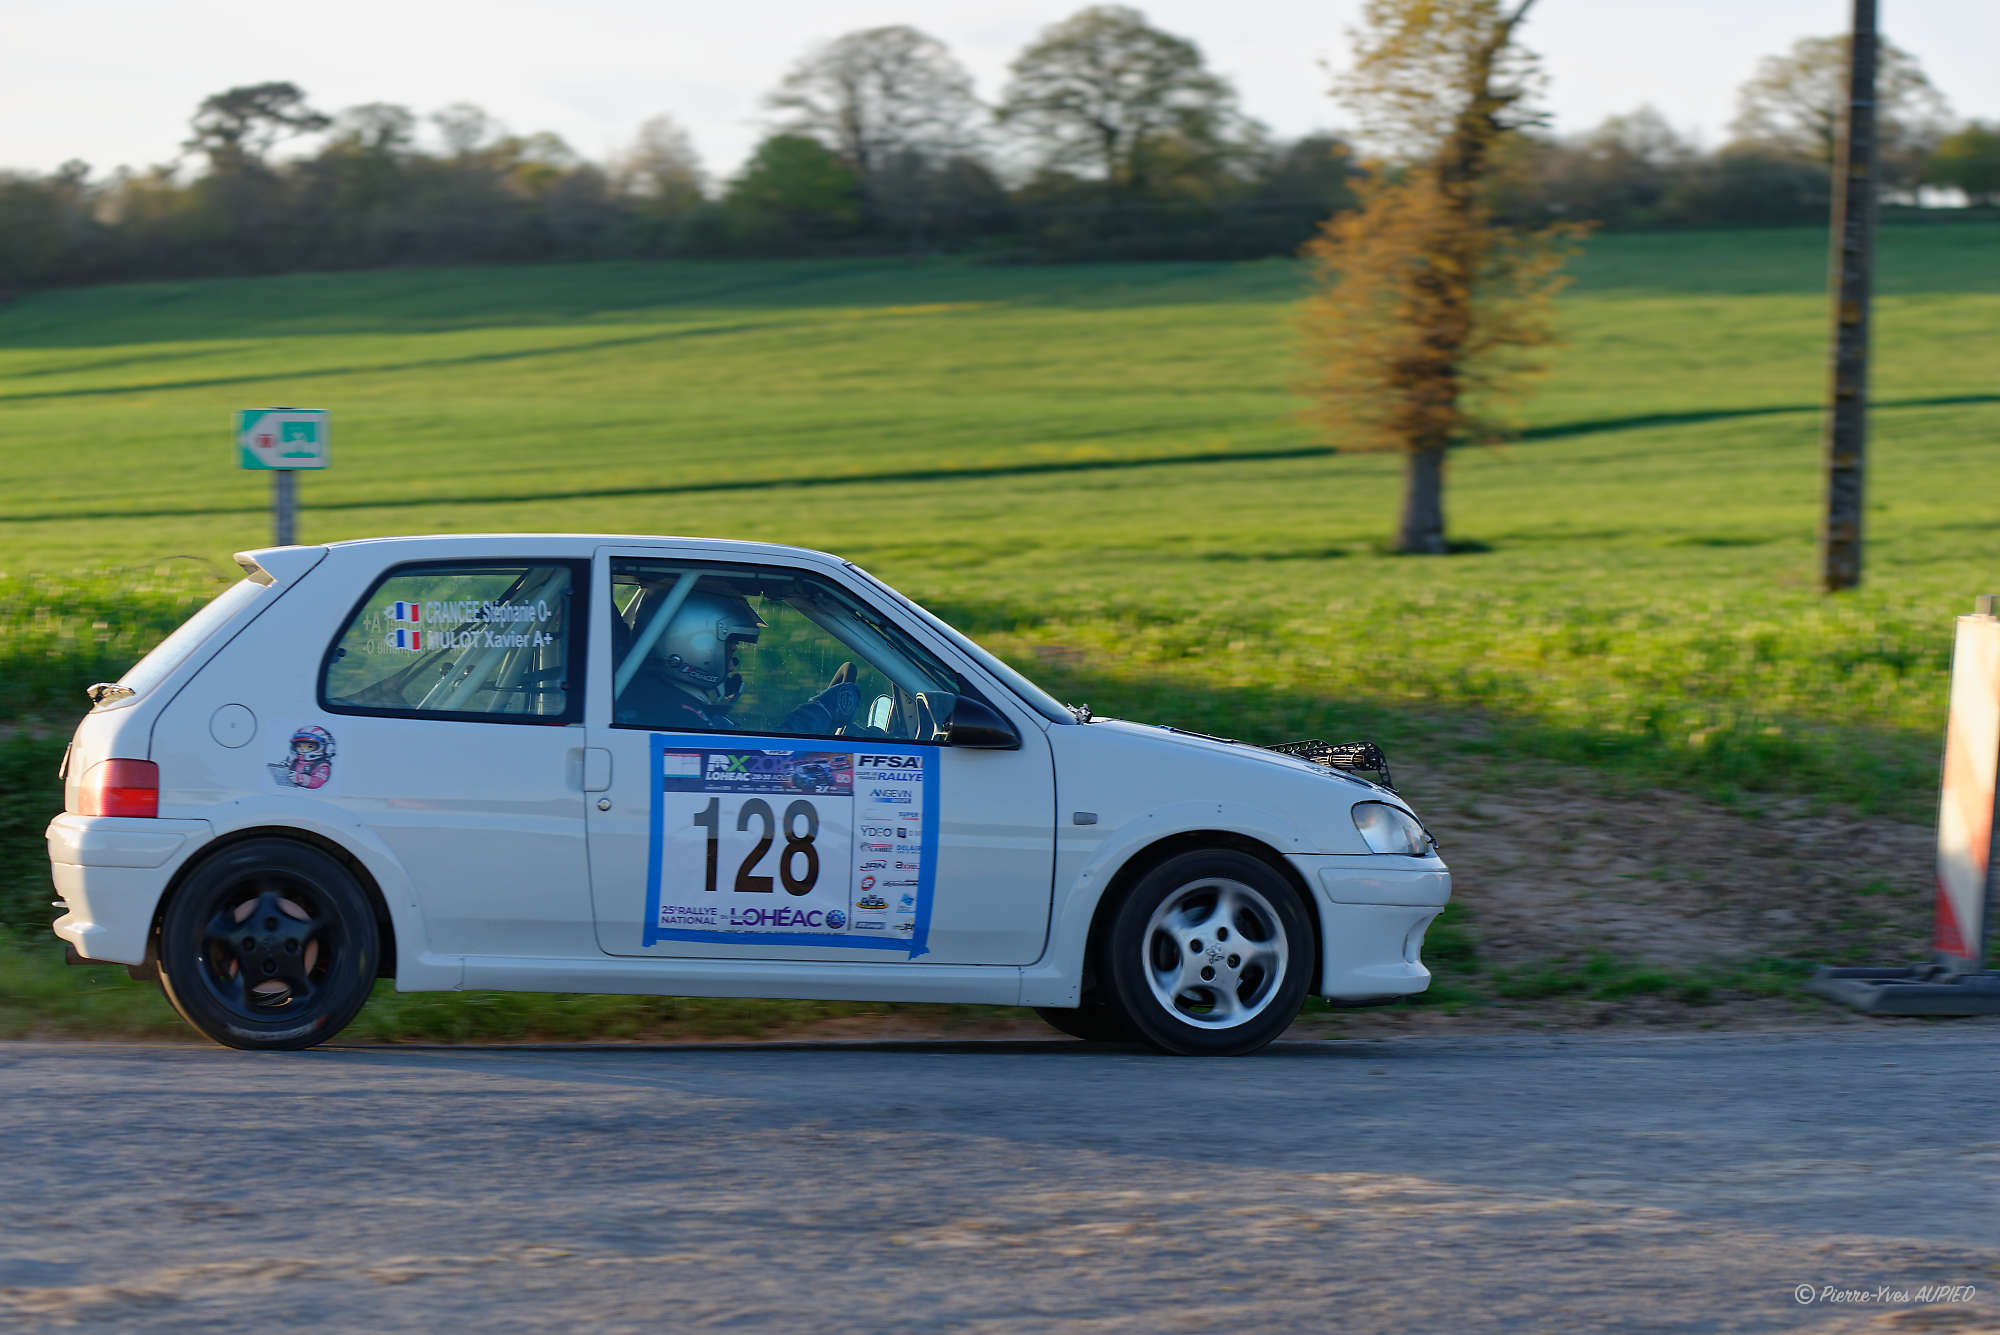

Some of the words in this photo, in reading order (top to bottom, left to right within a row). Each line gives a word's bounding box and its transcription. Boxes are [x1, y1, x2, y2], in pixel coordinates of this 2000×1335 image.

[484, 631, 530, 648] Xavier
[532, 630, 553, 648] A+
[858, 755, 919, 768] FFSA
[705, 772, 750, 781] LOHEAC
[877, 772, 923, 782] RALLYE
[693, 796, 820, 897] 128
[678, 906, 717, 916] RALLYE
[730, 906, 823, 927] LOHÉAC
[662, 915, 718, 925] NATIONAL
